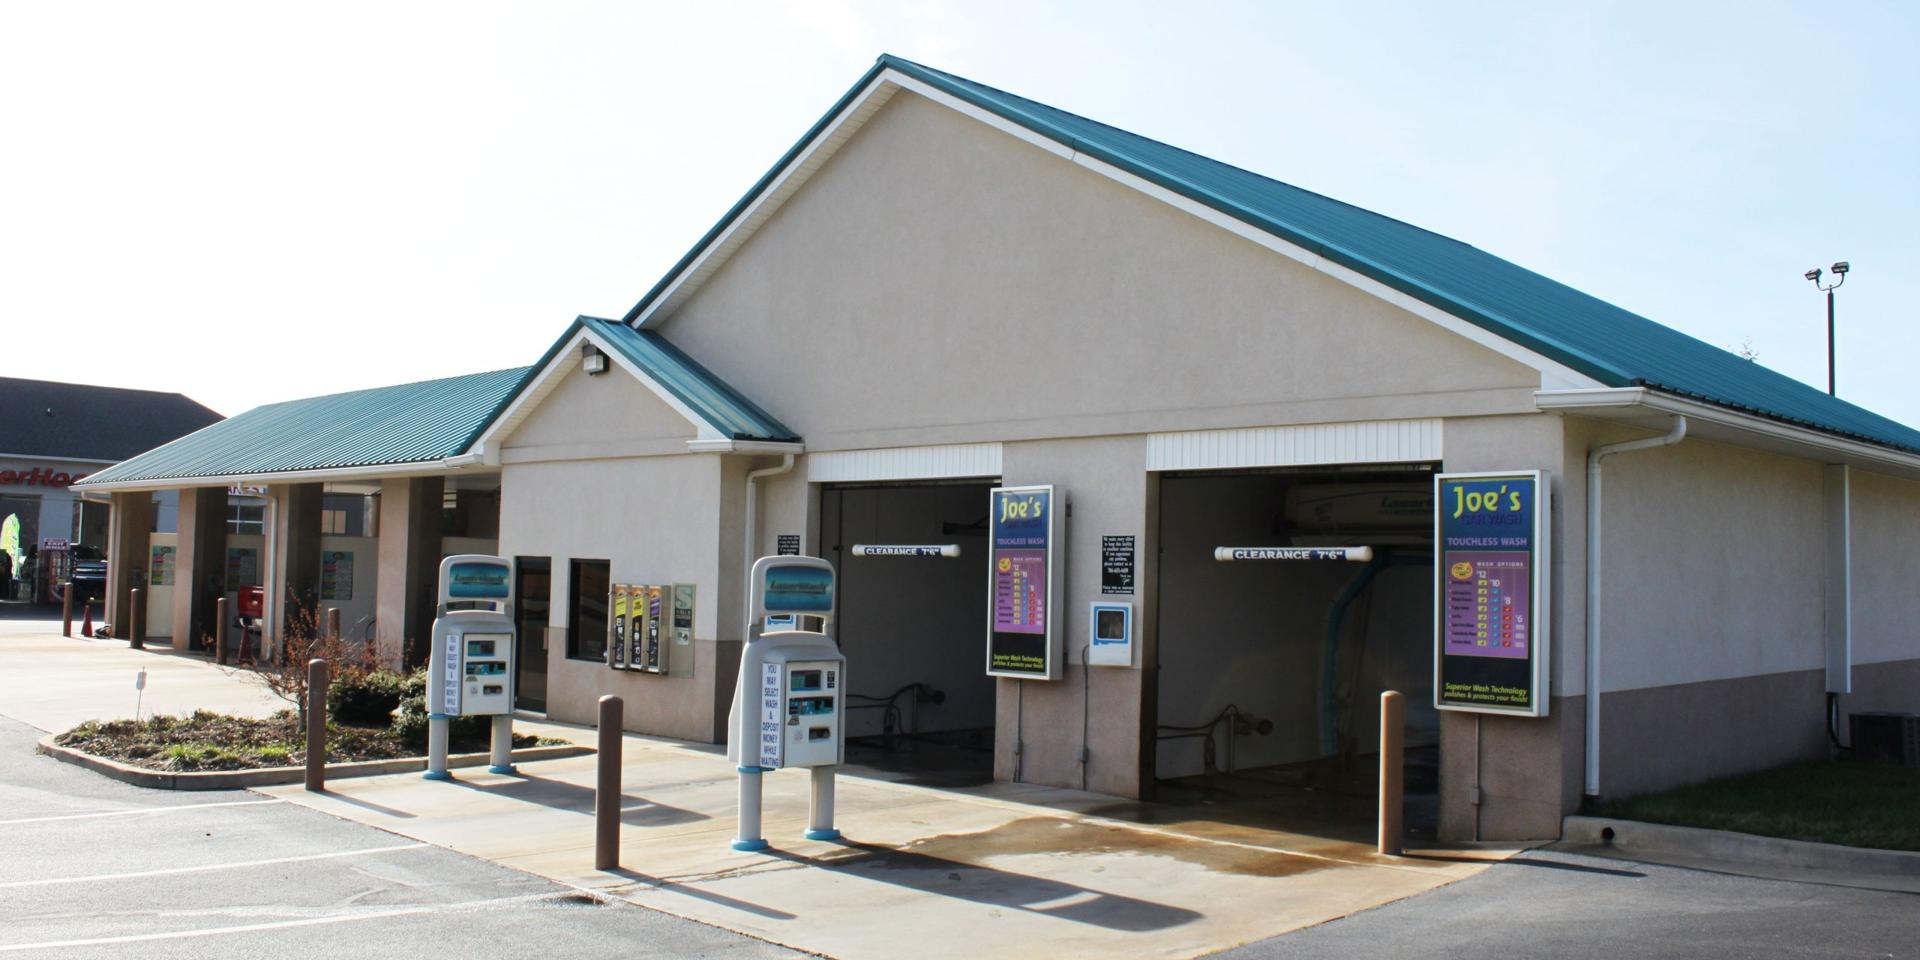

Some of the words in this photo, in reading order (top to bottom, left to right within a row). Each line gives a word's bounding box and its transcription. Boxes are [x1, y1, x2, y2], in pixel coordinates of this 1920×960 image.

[1453, 484, 1521, 519] Joe's
[1000, 496, 1041, 524] Joe's
[997, 537, 1026, 545] TOUCHLESS
[1027, 537, 1046, 545] WASH
[1447, 537, 1499, 546] TOUCHLESS
[1501, 537, 1528, 546] WASH
[865, 547, 917, 556] CLEARANCE
[1234, 550, 1311, 560] CLEARANCE
[1317, 550, 1343, 560] 7'6"
[767, 665, 777, 674] YOU
[766, 676, 776, 685] MAY
[764, 688, 779, 697] SELECT
[1445, 682, 1472, 693] Superior
[1472, 683, 1489, 692] Wash
[1491, 685, 1527, 697] Technology
[1444, 691, 1466, 699] polishes
[1472, 693, 1495, 701] protects
[765, 700, 778, 709] WASH
[762, 722, 779, 732] DEPOSIT
[763, 734, 778, 744] MONEY
[764, 746, 777, 755] WHILE
[761, 757, 779, 767] WAITING
